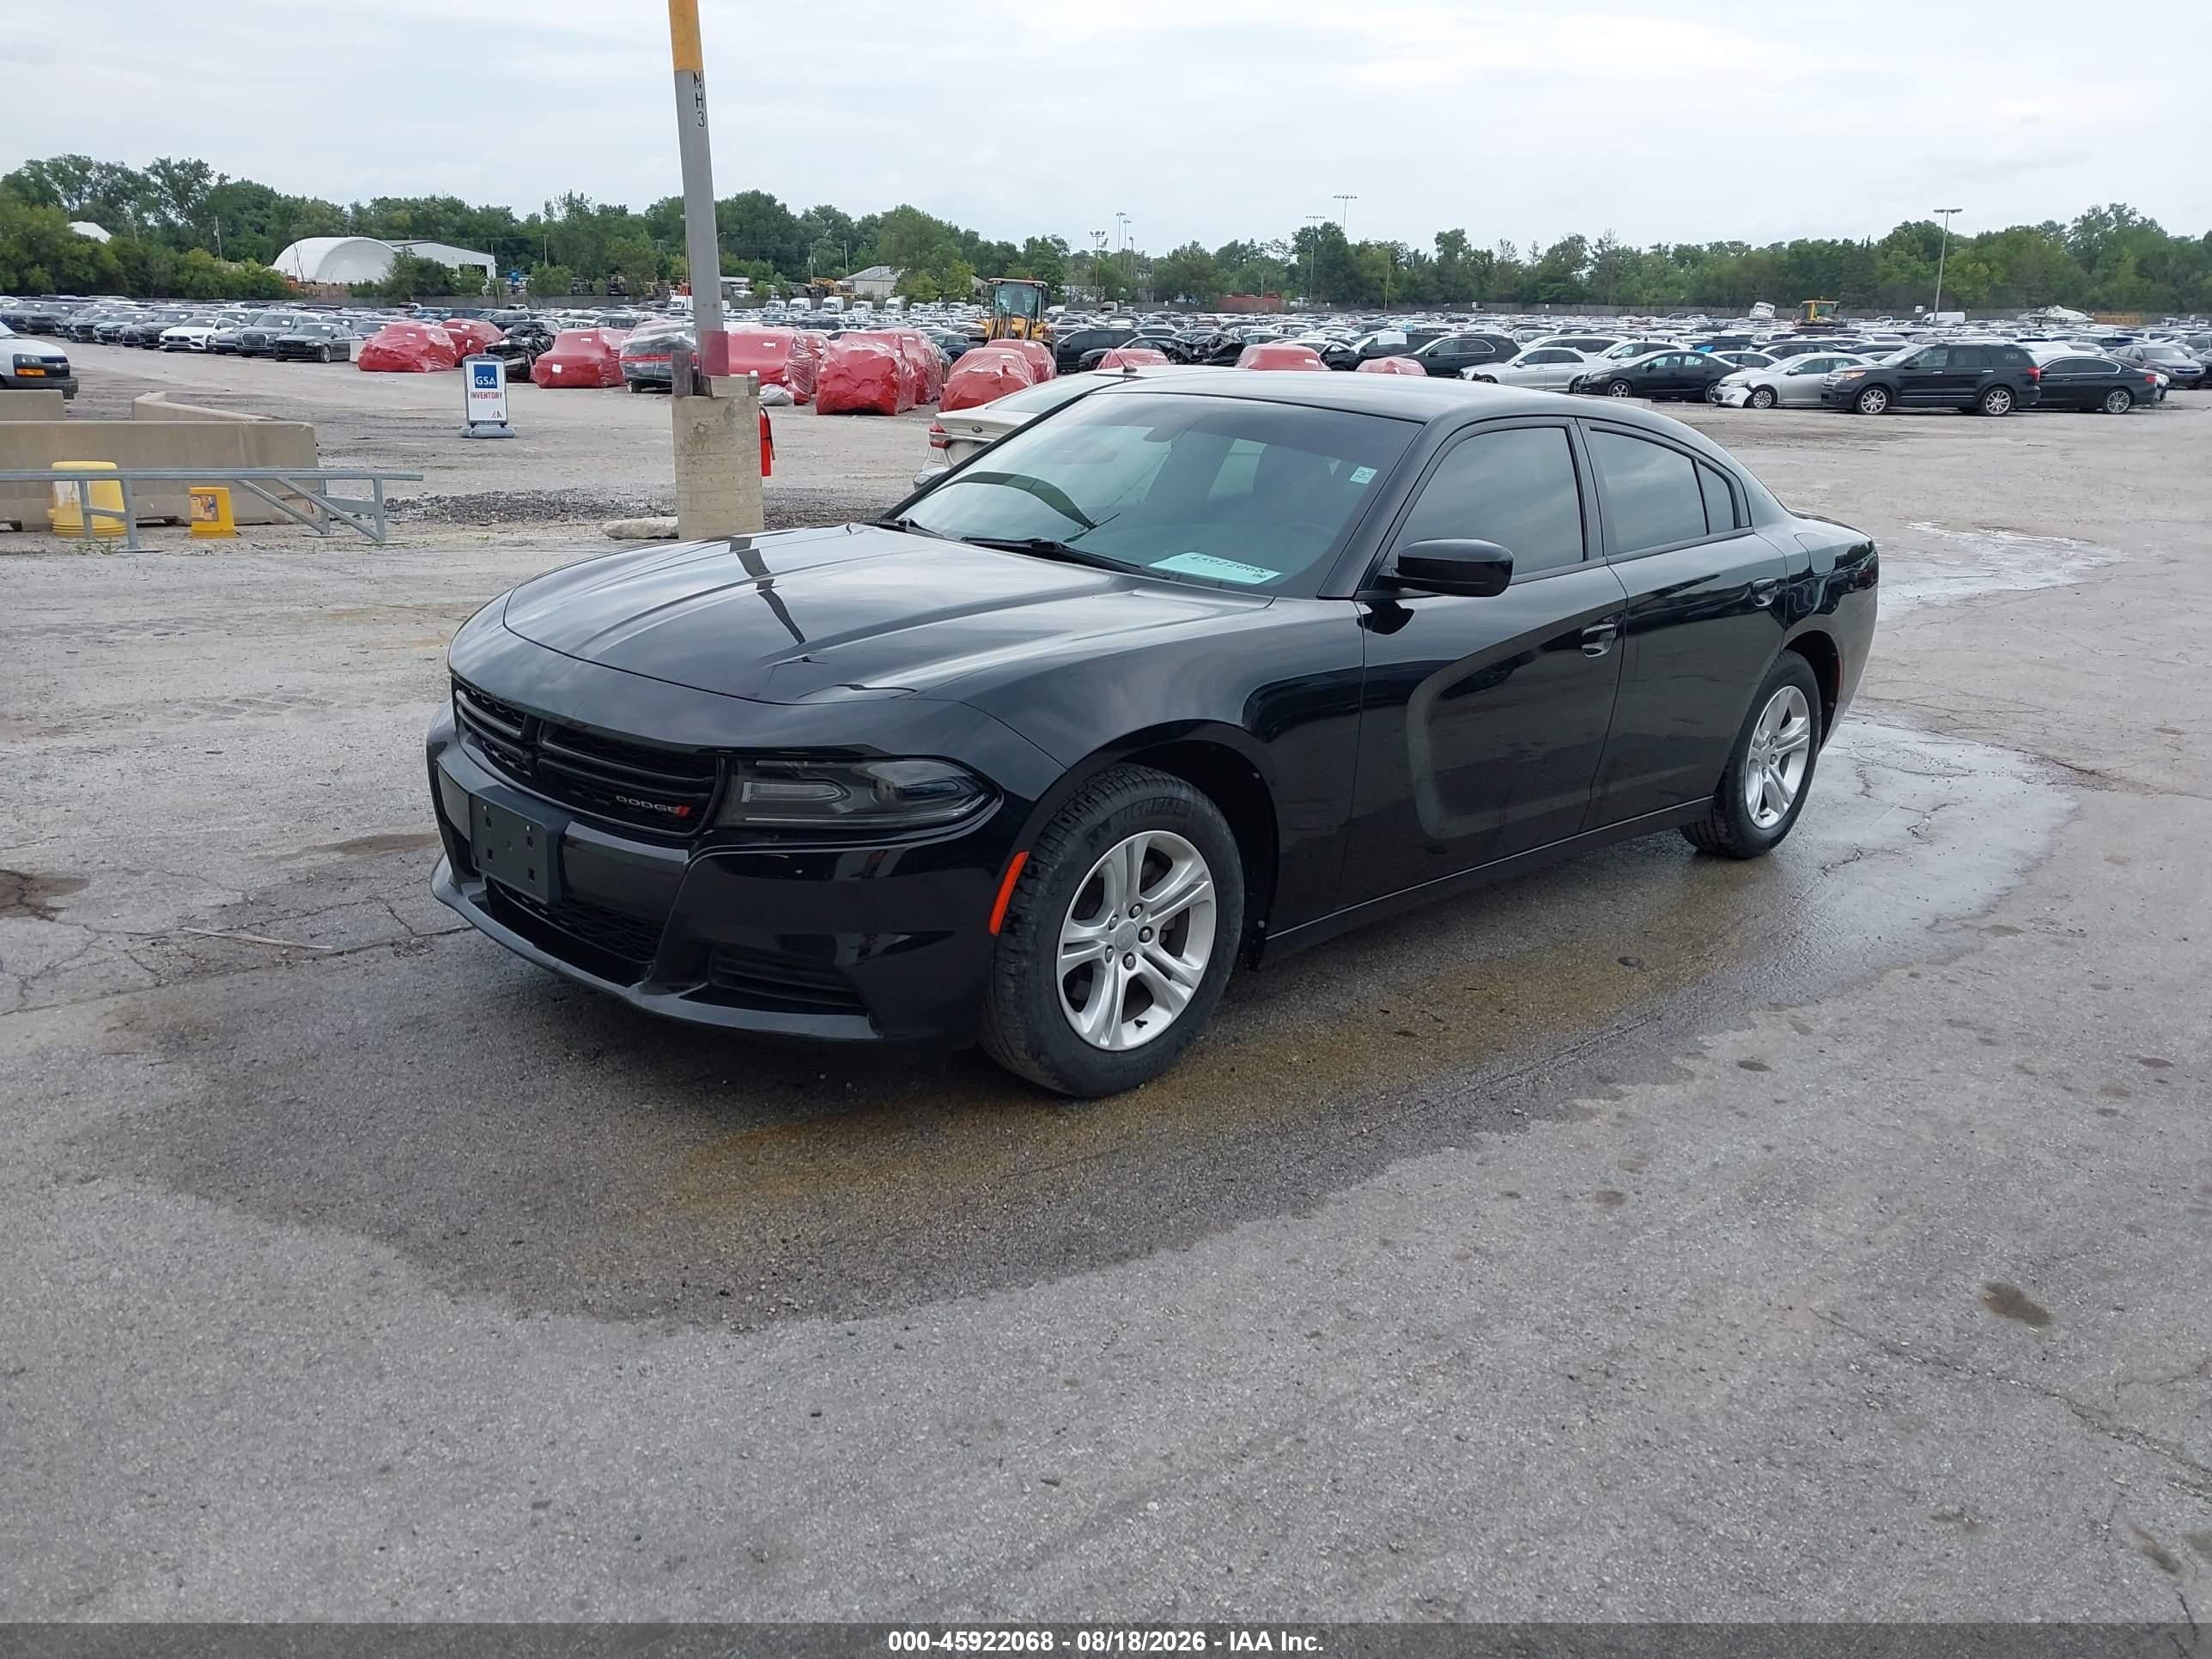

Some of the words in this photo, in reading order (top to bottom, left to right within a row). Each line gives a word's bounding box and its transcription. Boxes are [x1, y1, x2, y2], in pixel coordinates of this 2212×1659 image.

[476, 376, 496, 386] GSA
[470, 391, 503, 399] INVENTORY
[616, 795, 679, 814] DODGE
